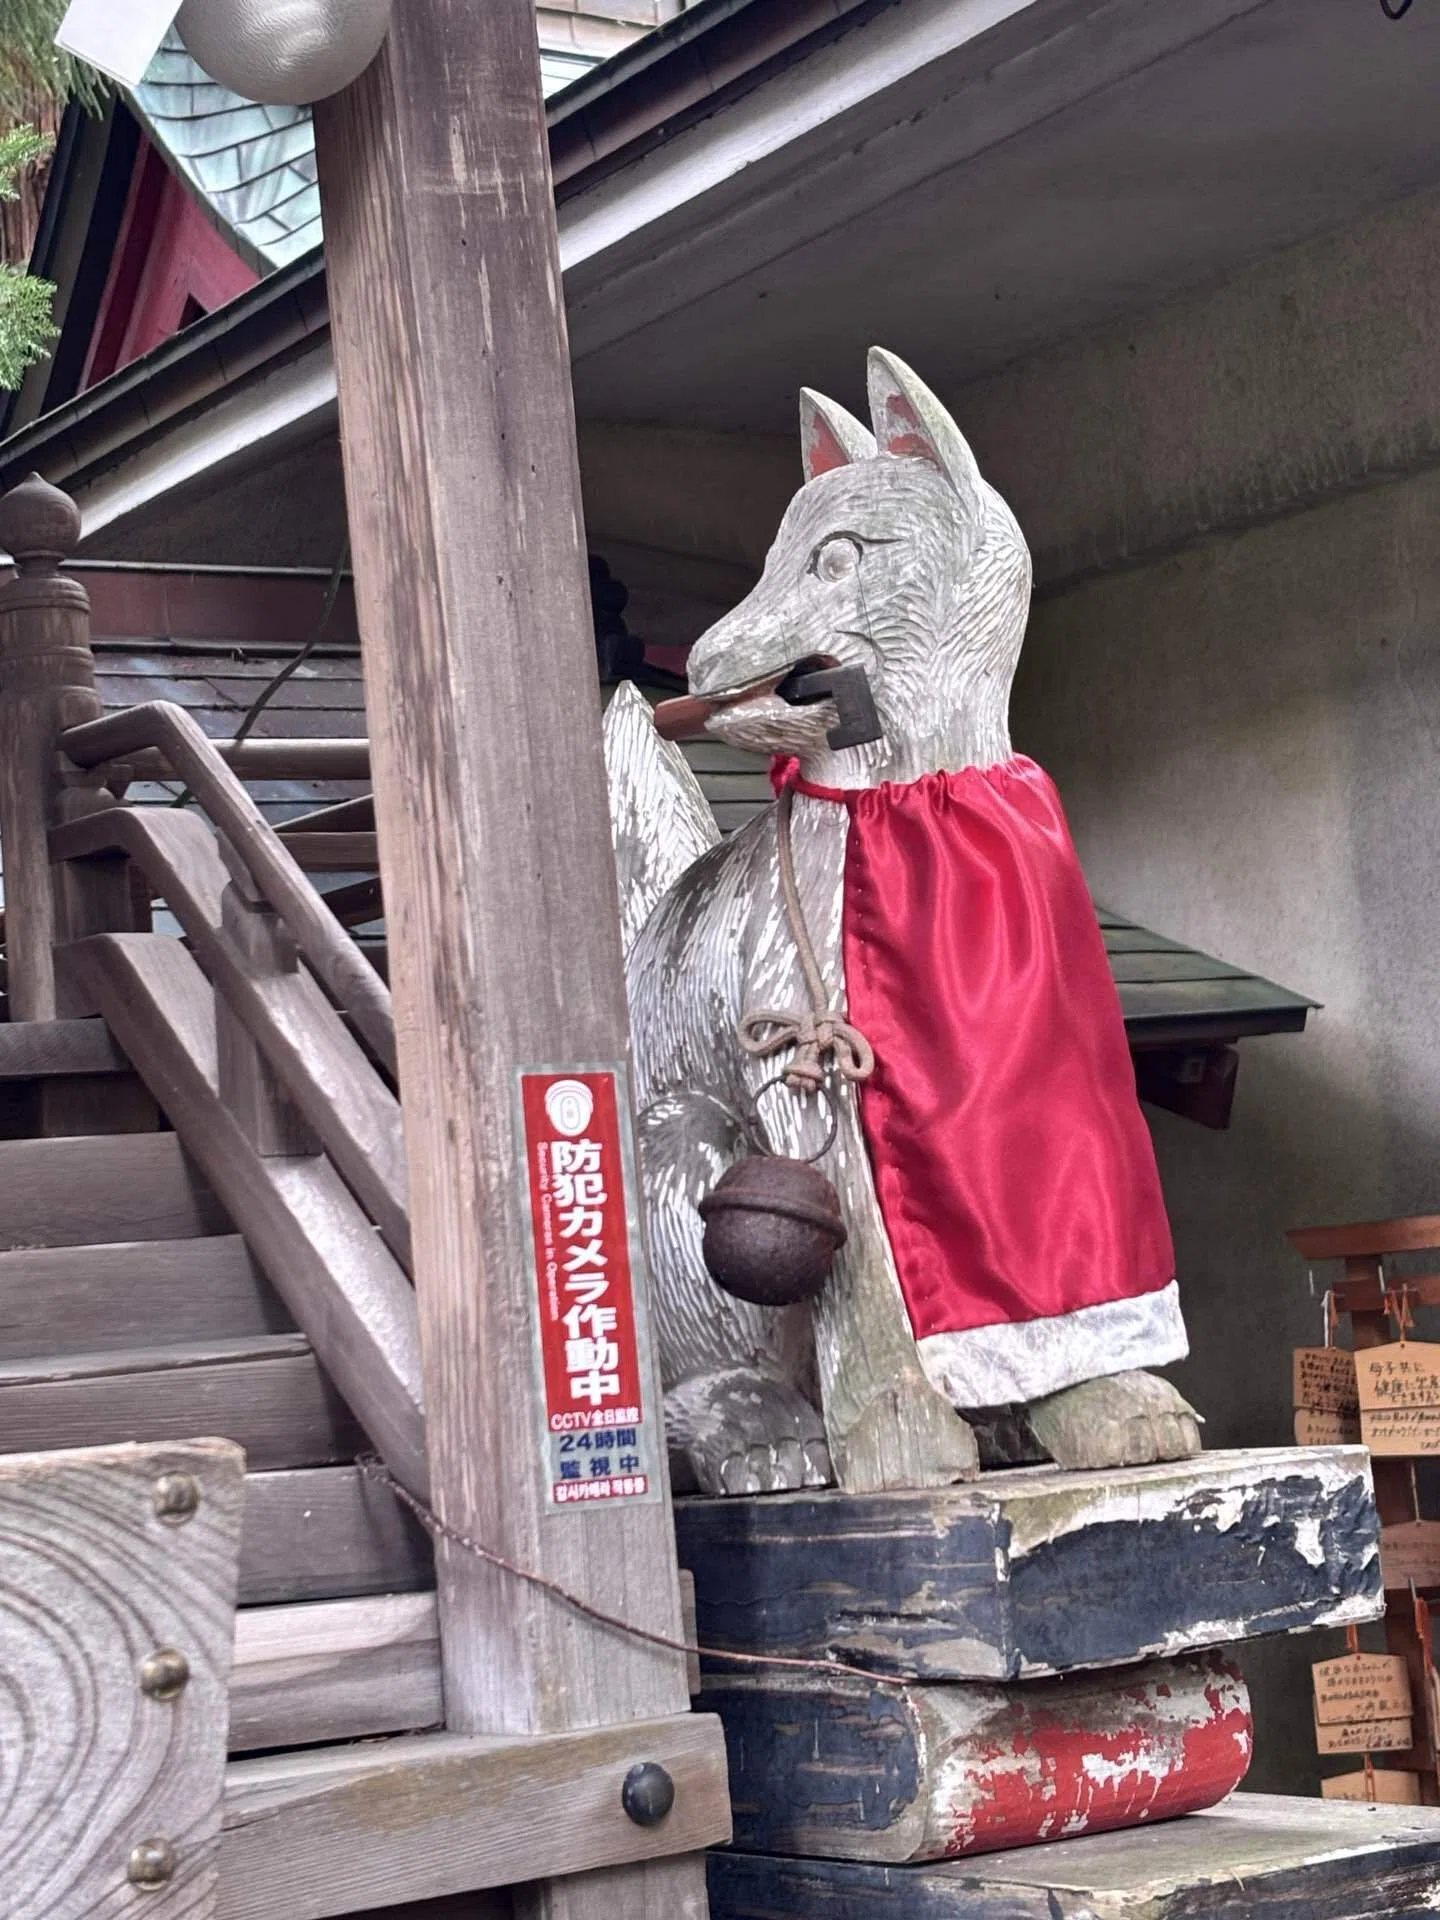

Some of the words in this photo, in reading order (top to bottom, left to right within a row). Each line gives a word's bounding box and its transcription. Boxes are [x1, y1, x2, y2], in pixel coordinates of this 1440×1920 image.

[537, 1142, 549, 1190] Security
[547, 1263, 559, 1320] Operation
[551, 1138, 620, 1405] 防犯カメラ作動中
[559, 1428, 636, 1452] 24時間
[560, 1454, 639, 1479] 監視中
